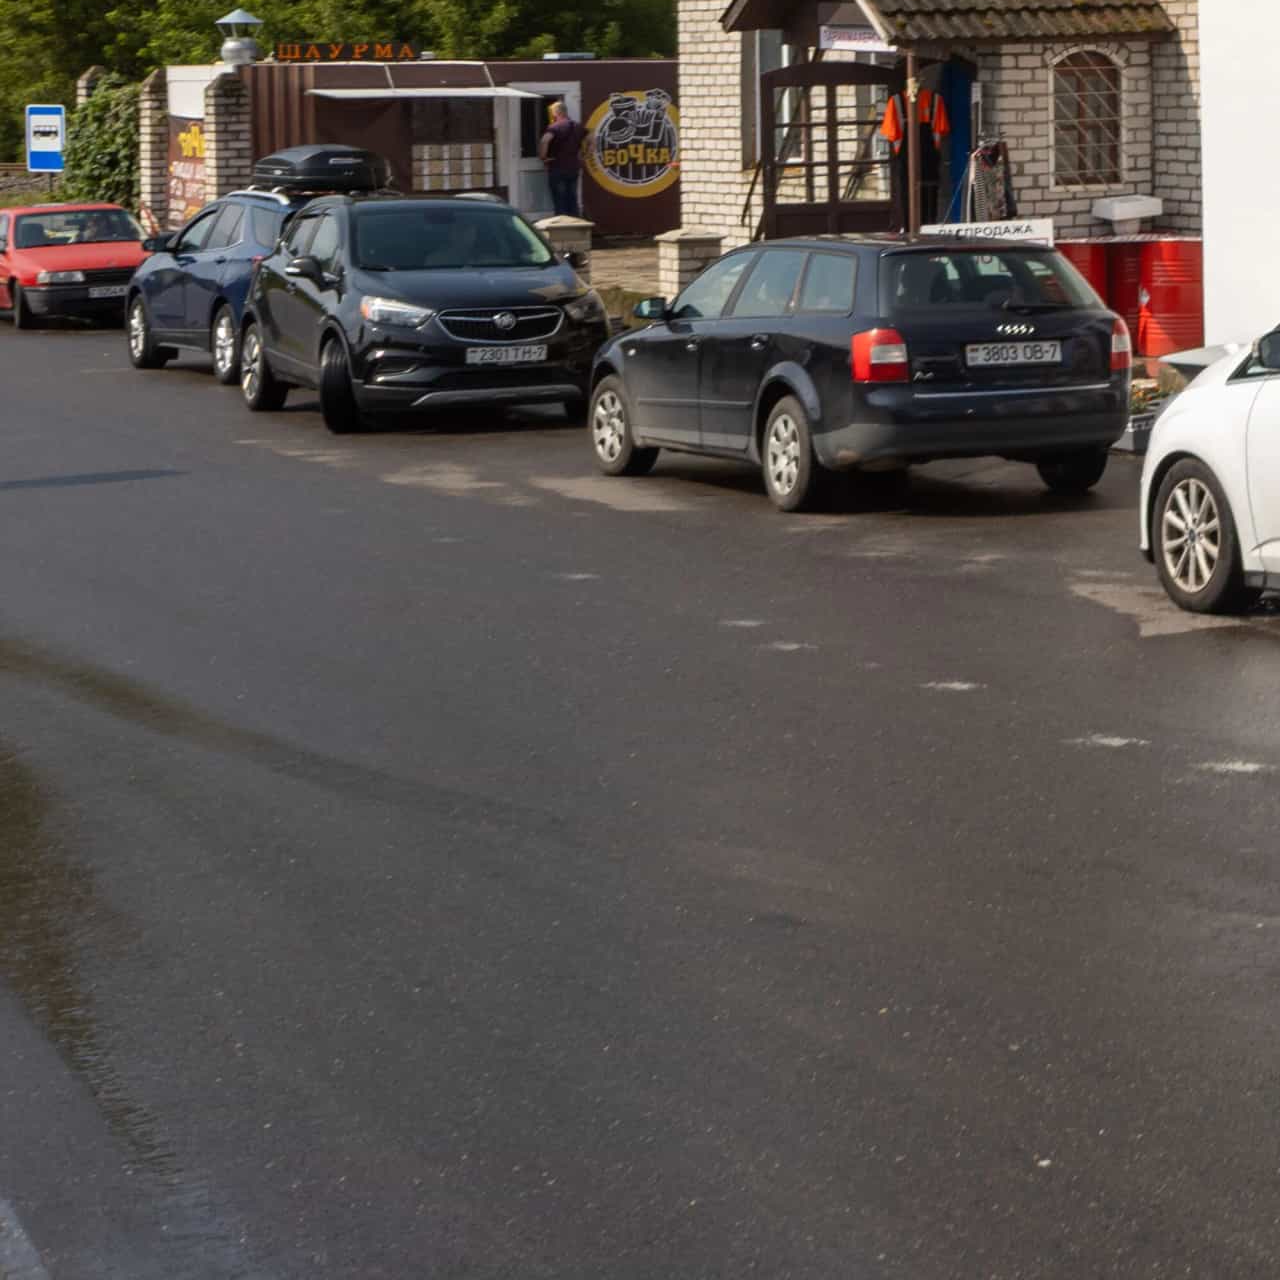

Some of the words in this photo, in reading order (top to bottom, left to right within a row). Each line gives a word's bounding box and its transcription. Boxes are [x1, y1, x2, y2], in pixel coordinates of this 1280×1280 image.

[277, 43, 415, 59] ШАУРМА
[603, 144, 671, 167] БОЧКА
[983, 346, 1018, 362] 3803
